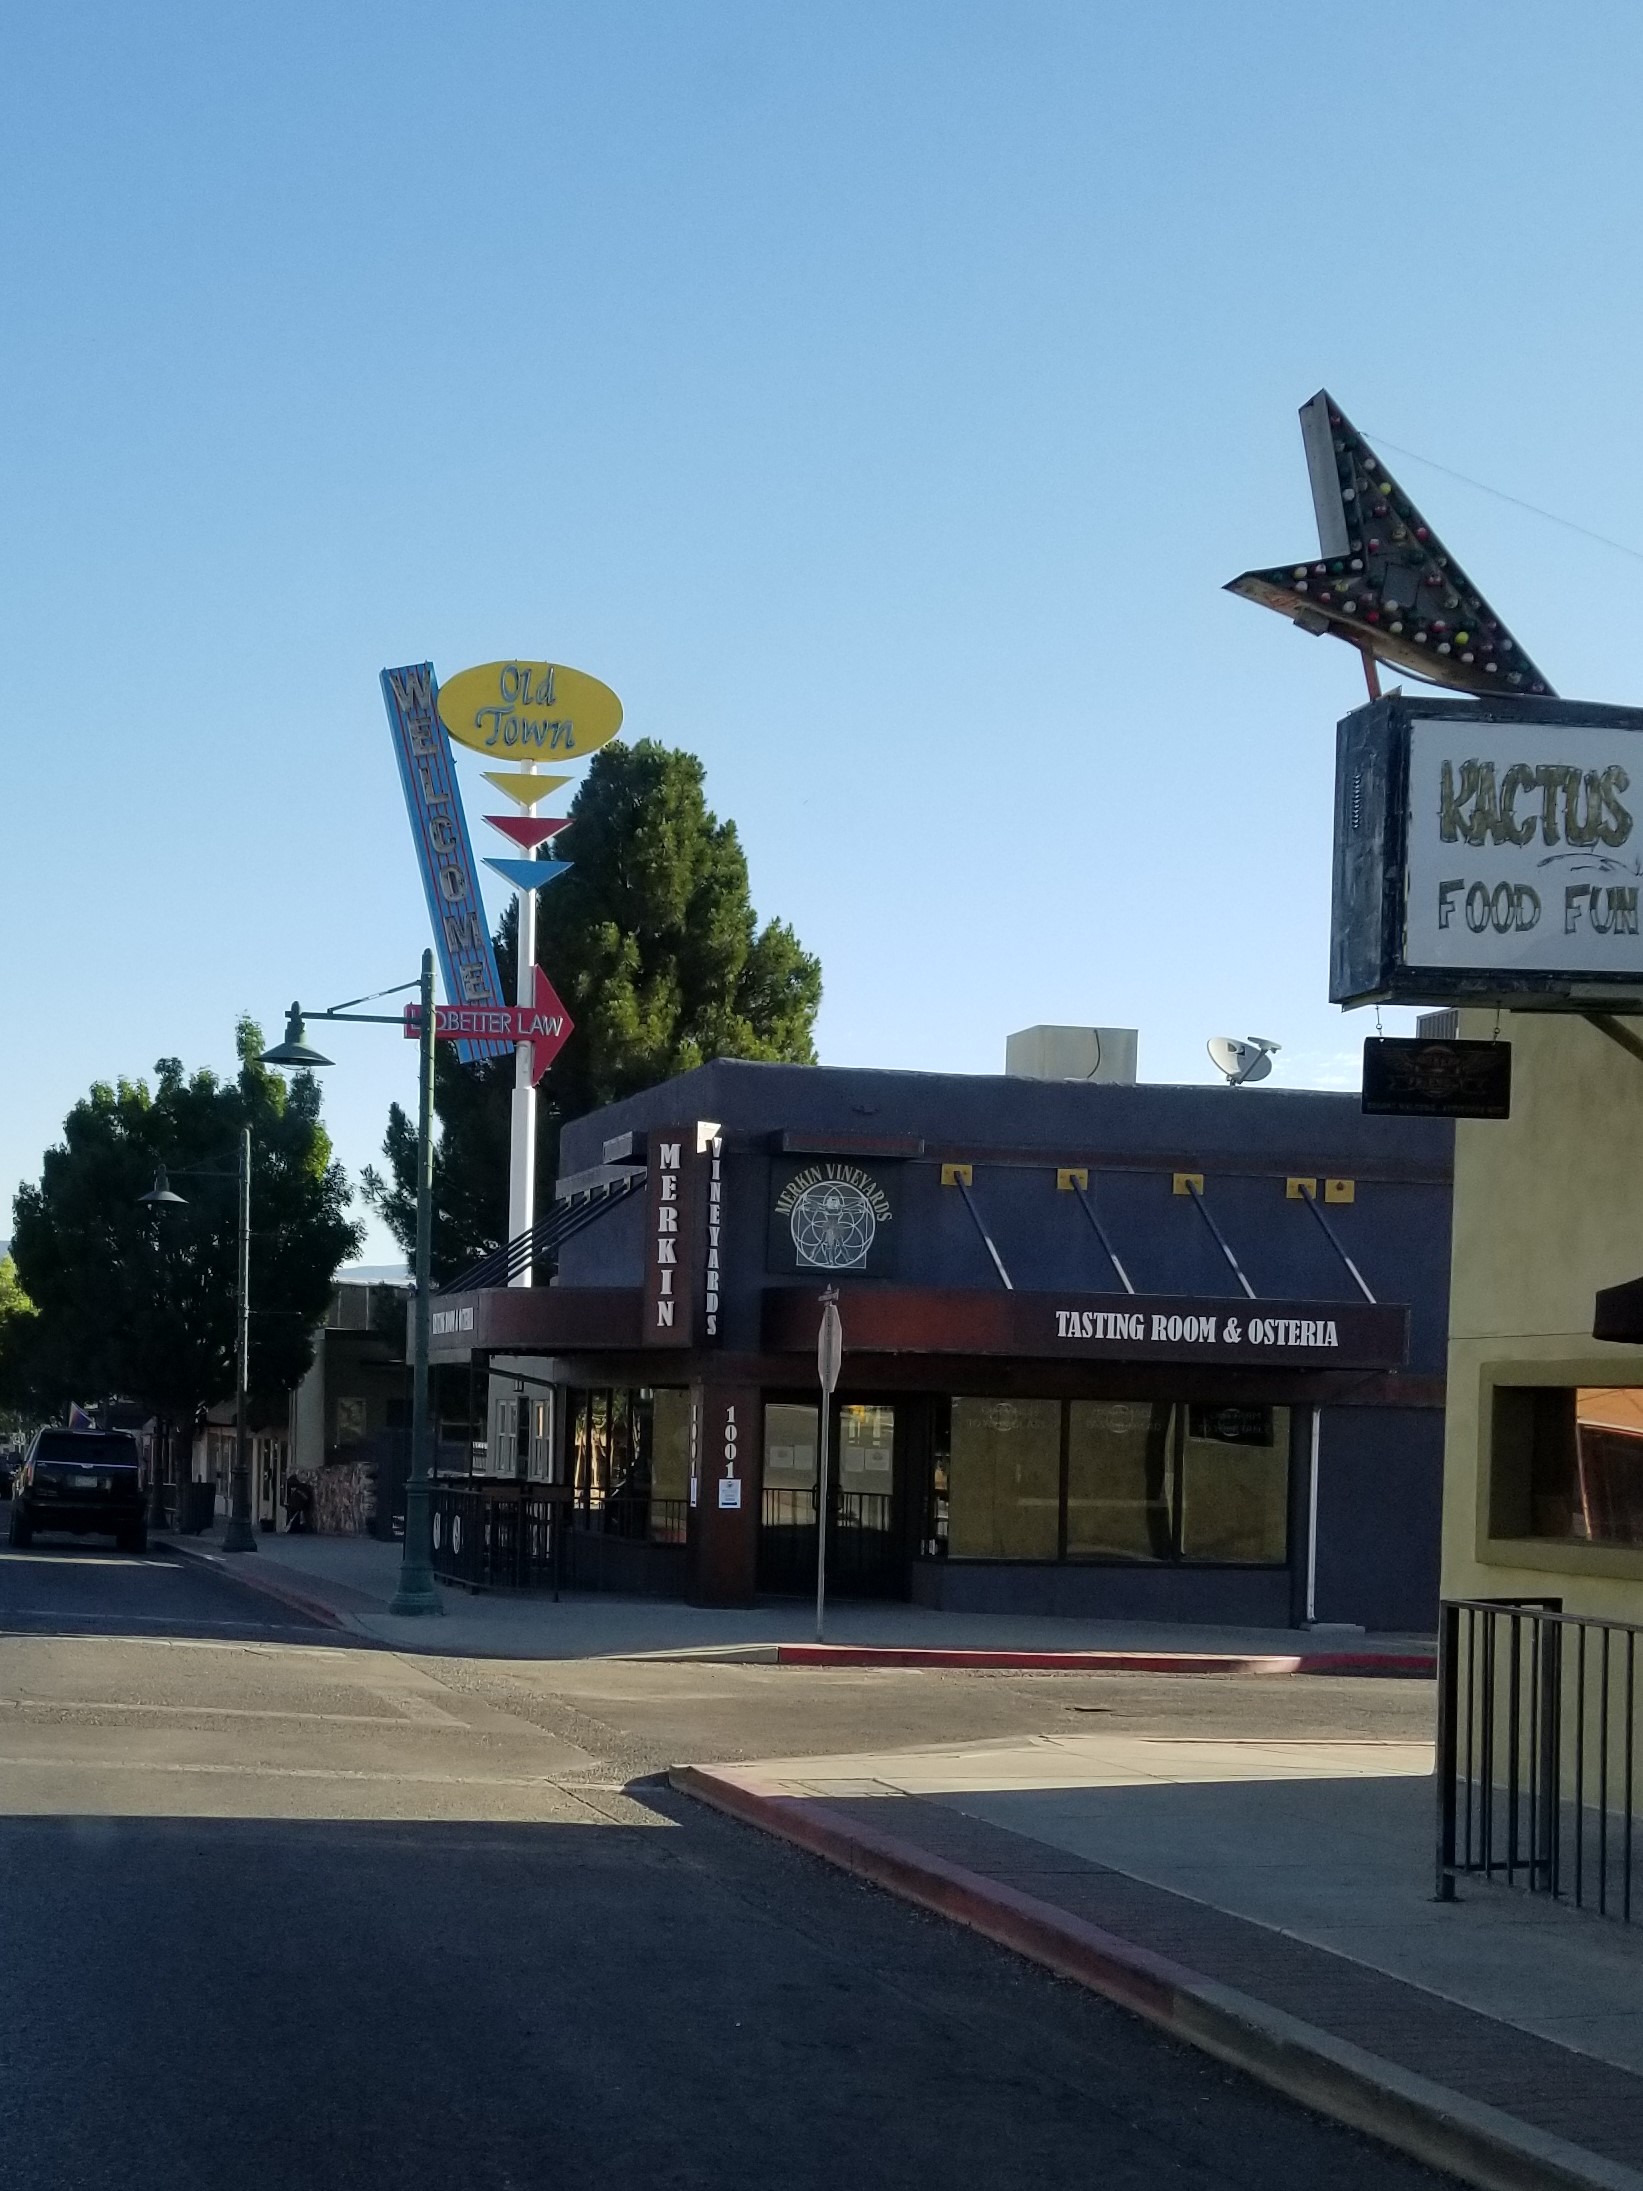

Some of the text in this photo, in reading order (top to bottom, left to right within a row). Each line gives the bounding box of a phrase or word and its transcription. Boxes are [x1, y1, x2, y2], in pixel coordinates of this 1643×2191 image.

[500, 664, 557, 706] Old
[475, 706, 575, 749] Town
[1438, 758, 1634, 848] KACTUS
[390, 668, 491, 1001] WELCOME
[1438, 878, 1639, 936] FOOD FUN
[410, 1009, 564, 1037] LDBETTER LAW
[774, 1163, 893, 1222] MERKIN VINEYARDS
[657, 1143, 681, 1327] MERKIN
[706, 1136, 723, 1335] VINEYARDS
[1055, 1311, 1339, 1347] TASTING ROOM & OSTERIA
[724, 1406, 737, 1477] 1001
